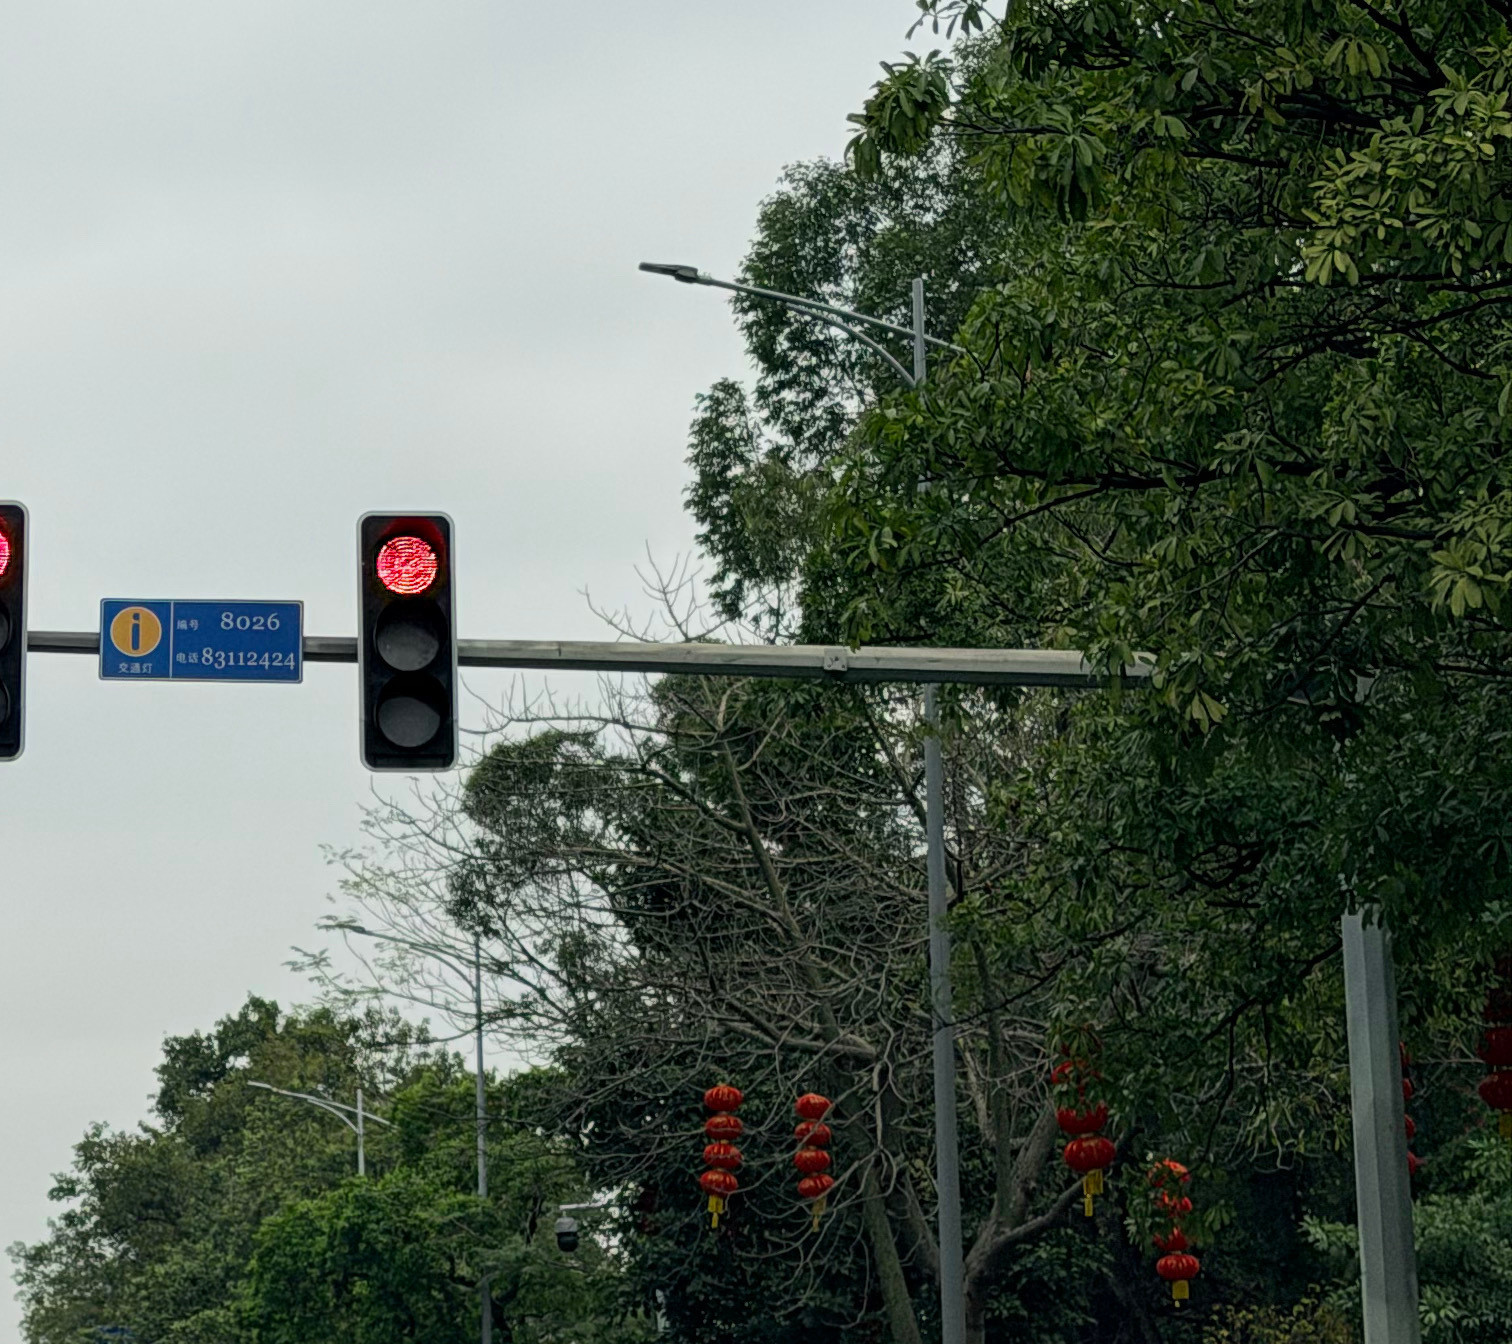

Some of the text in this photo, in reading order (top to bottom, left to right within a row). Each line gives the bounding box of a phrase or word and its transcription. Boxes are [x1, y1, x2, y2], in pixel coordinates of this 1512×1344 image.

[177, 611, 280, 631] 编号 8026
[118, 662, 152, 674] 交通灯
[176, 647, 296, 670] 电话 83112424
